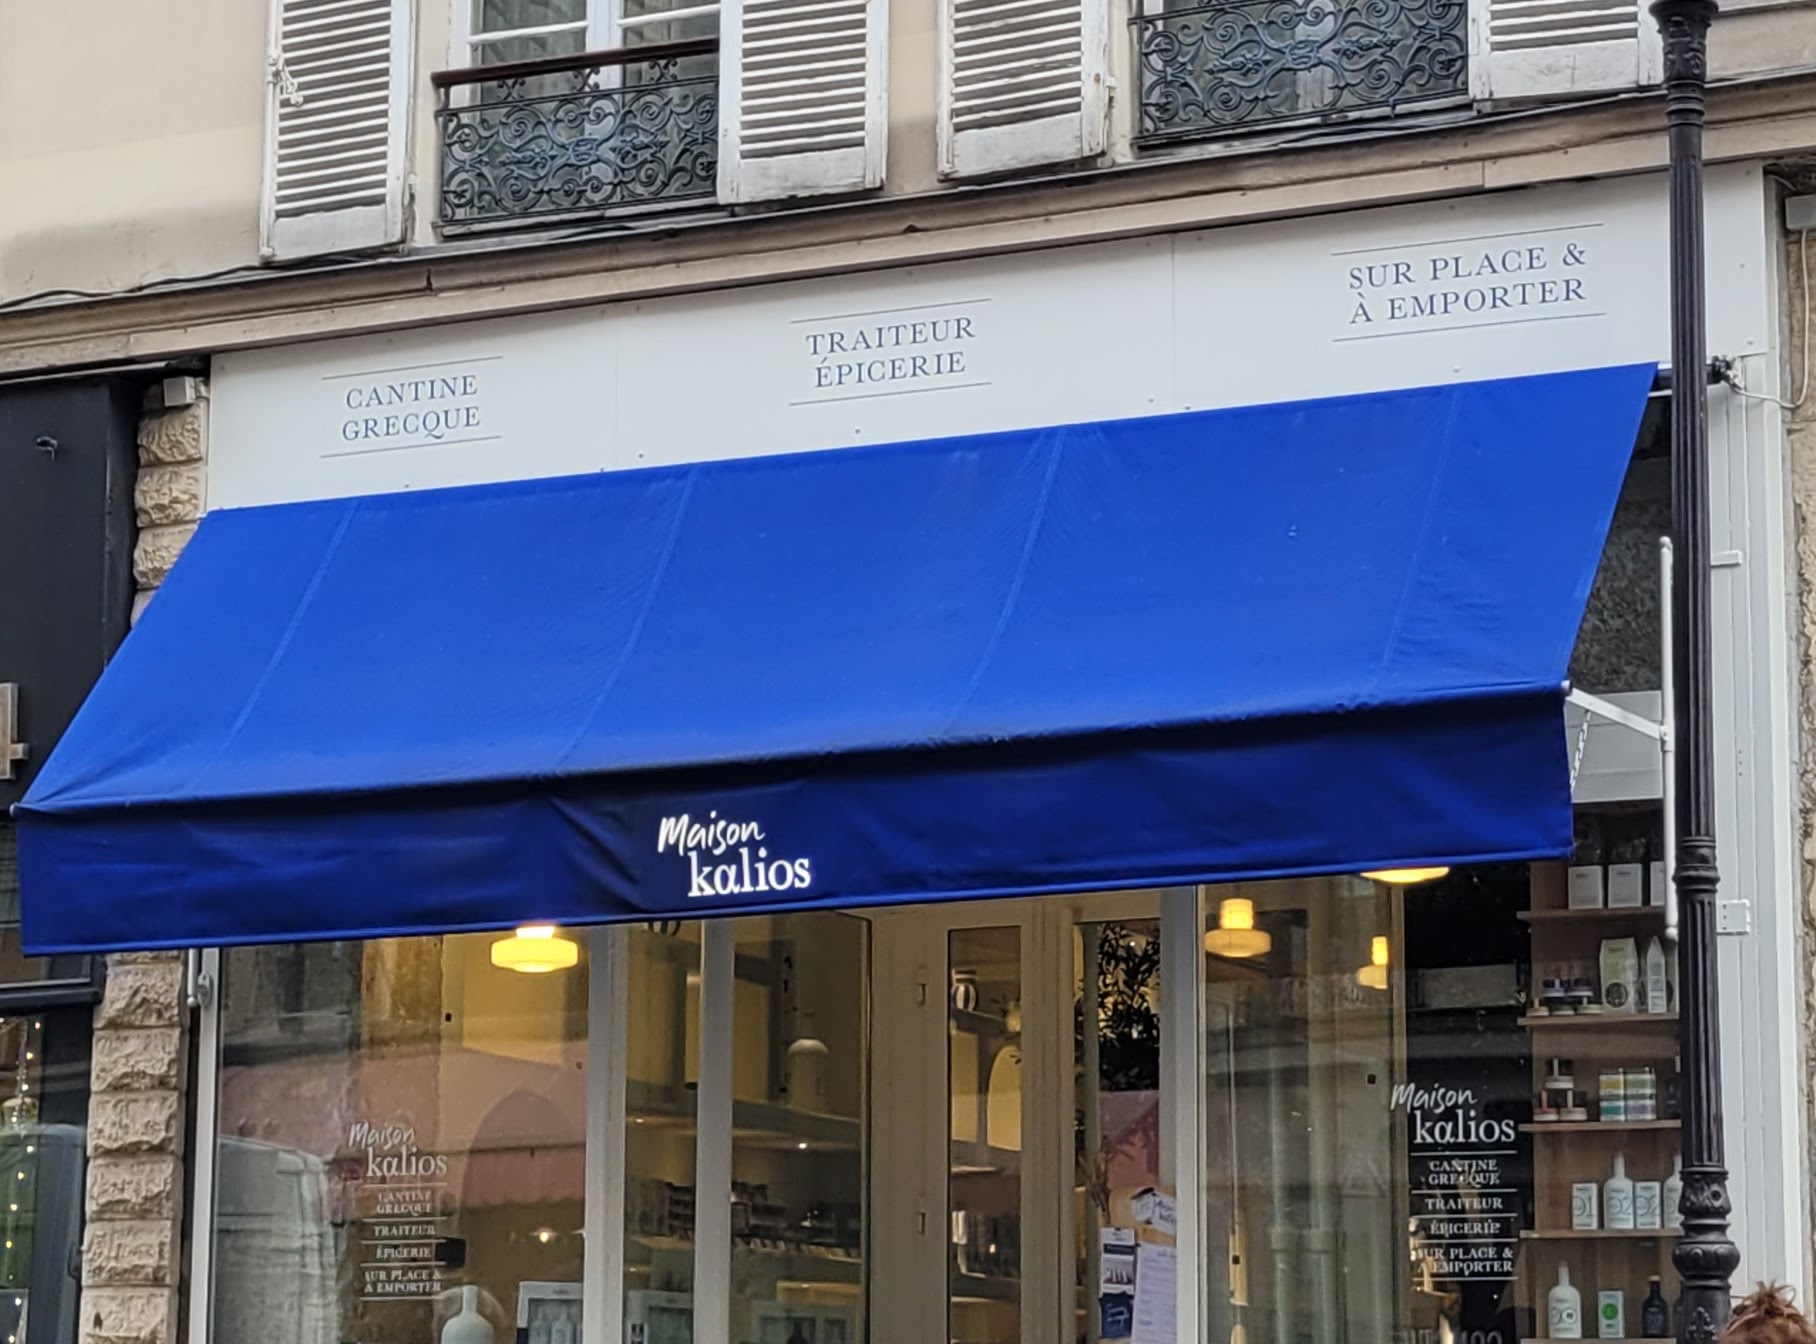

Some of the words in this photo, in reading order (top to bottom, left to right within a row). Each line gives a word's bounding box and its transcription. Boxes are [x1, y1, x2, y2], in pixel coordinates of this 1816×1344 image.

[1349, 262, 1416, 290] SUR
[1429, 246, 1548, 281] PLACE
[1562, 242, 1587, 266] &
[1349, 292, 1373, 324] À
[1387, 278, 1587, 320] EMPORTER
[806, 317, 976, 356] TRAITEUR
[815, 351, 966, 388] ÉPICERIE
[346, 374, 478, 409] CANTINE
[342, 406, 480, 441] GRECQUE
[657, 810, 766, 856] Maison
[688, 846, 811, 897] kalios
[1391, 1082, 1477, 1114] Maison
[349, 1121, 415, 1150] Maison
[1413, 1108, 1516, 1144] kalios
[366, 1146, 448, 1177] kalios
[1429, 1159, 1498, 1172] CANTINE
[1428, 1172, 1500, 1188] GRECQUE
[1425, 1197, 1503, 1210] TRAITEUR
[374, 1224, 436, 1236] TRAITEUR
[1430, 1219, 1501, 1235] ÉPICERIE
[1432, 1260, 1514, 1273] EMPORTER
[1449, 1247, 1498, 1260] PLACE
[1502, 1246, 1514, 1259] &
[377, 1281, 442, 1293] EMPORTER
[391, 1269, 429, 1281] PLACE
